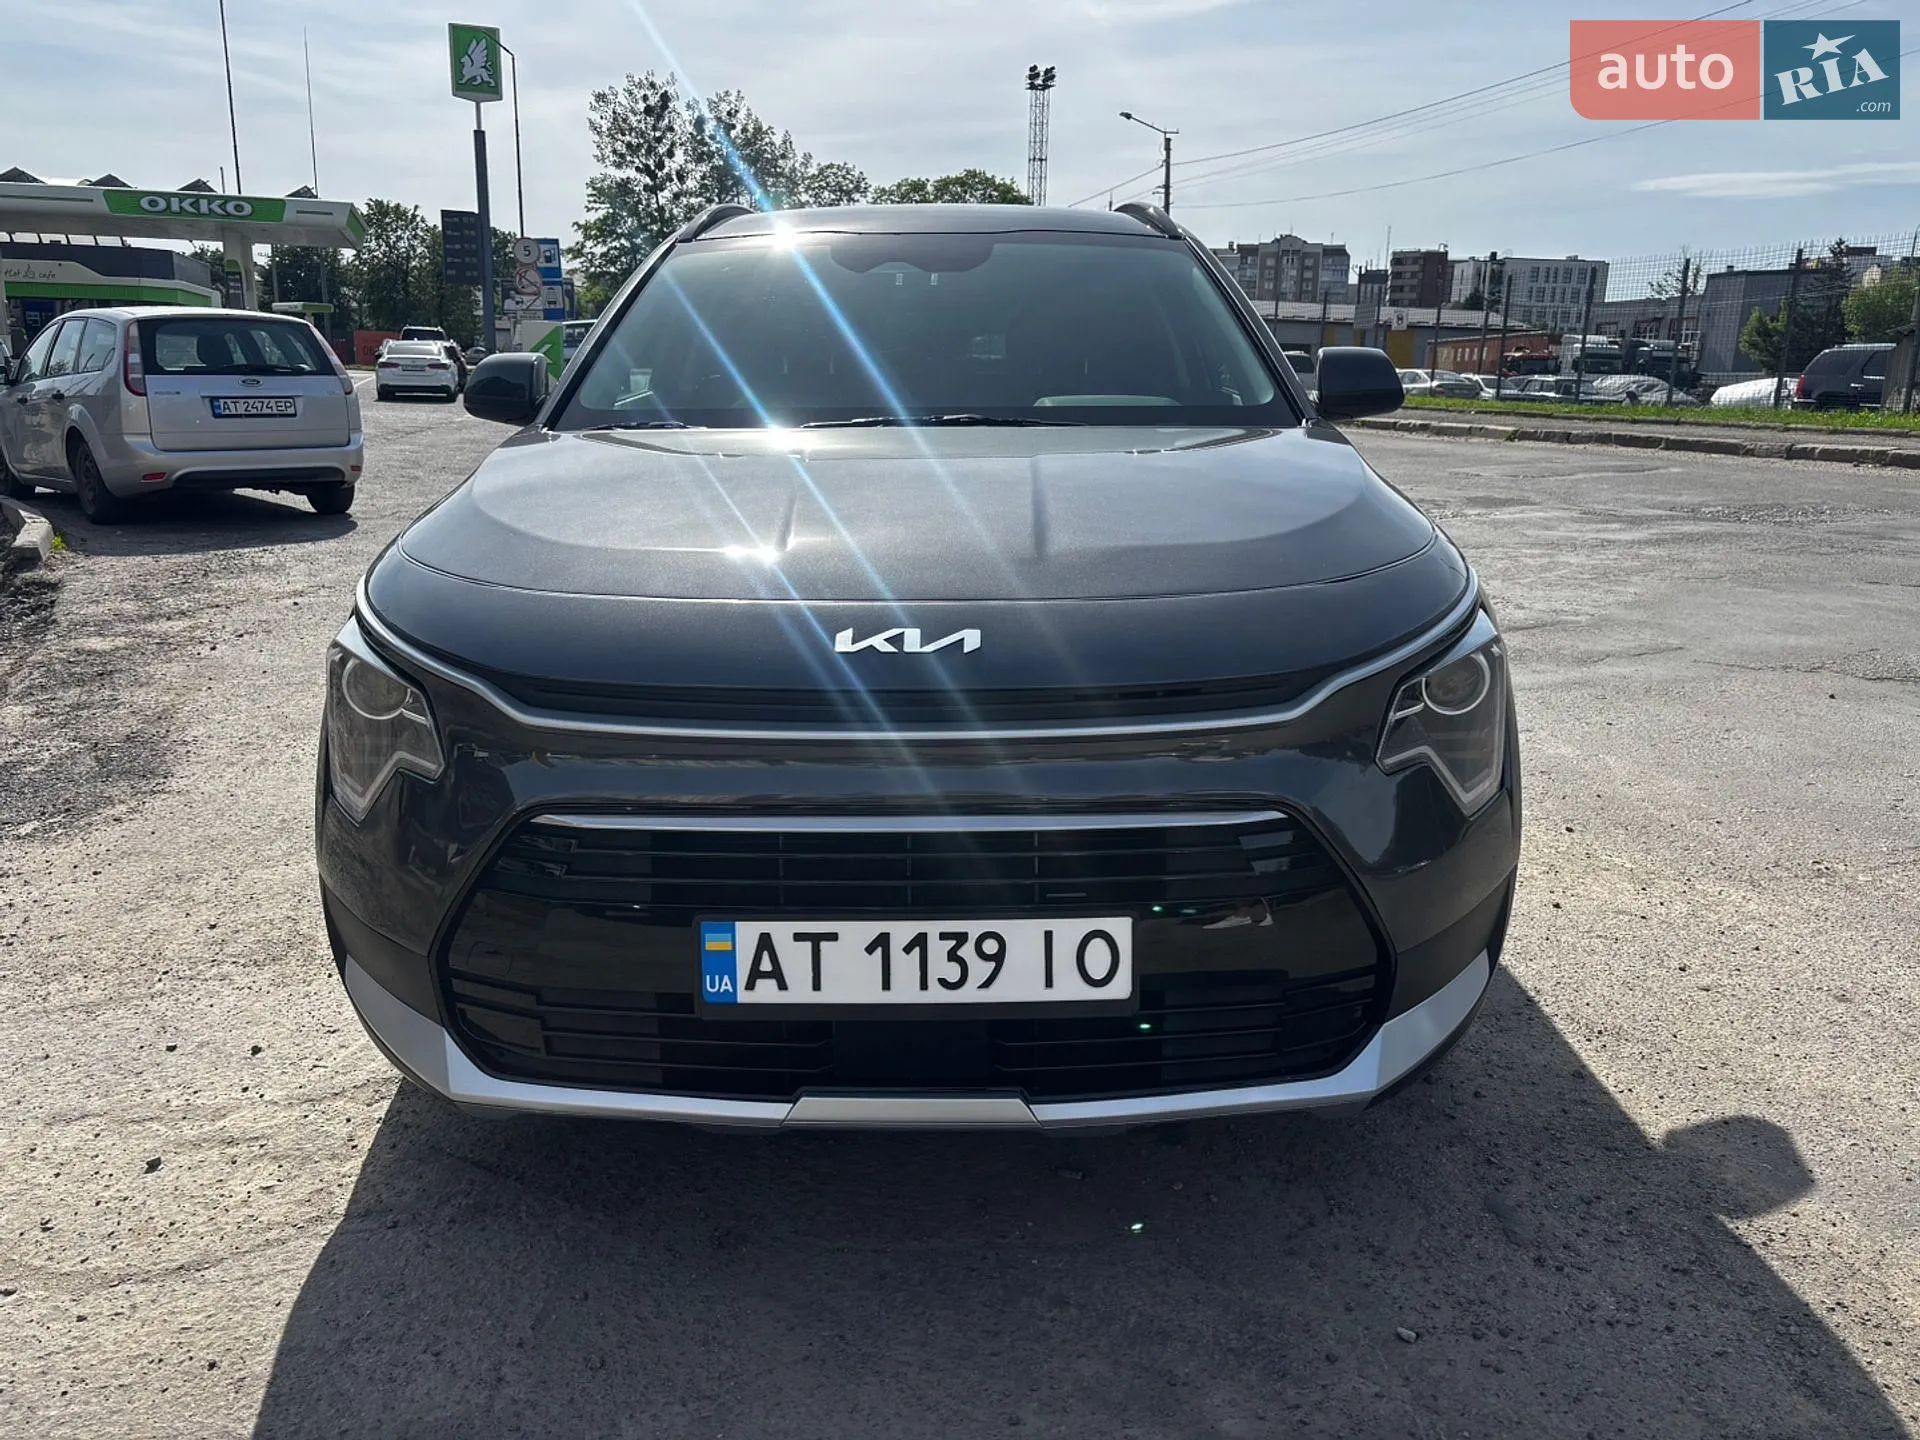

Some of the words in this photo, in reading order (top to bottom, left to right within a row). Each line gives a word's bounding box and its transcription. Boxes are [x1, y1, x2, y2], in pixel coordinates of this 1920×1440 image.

[140, 195, 253, 217] OKKO
[523, 245, 531, 257] 5
[222, 401, 240, 412] AT
[243, 400, 273, 412] 2474
[275, 400, 293, 411] EP
[744, 931, 840, 992] AT
[864, 930, 1007, 992] 1139
[1044, 928, 1121, 989] IO
[706, 975, 733, 993] UA
